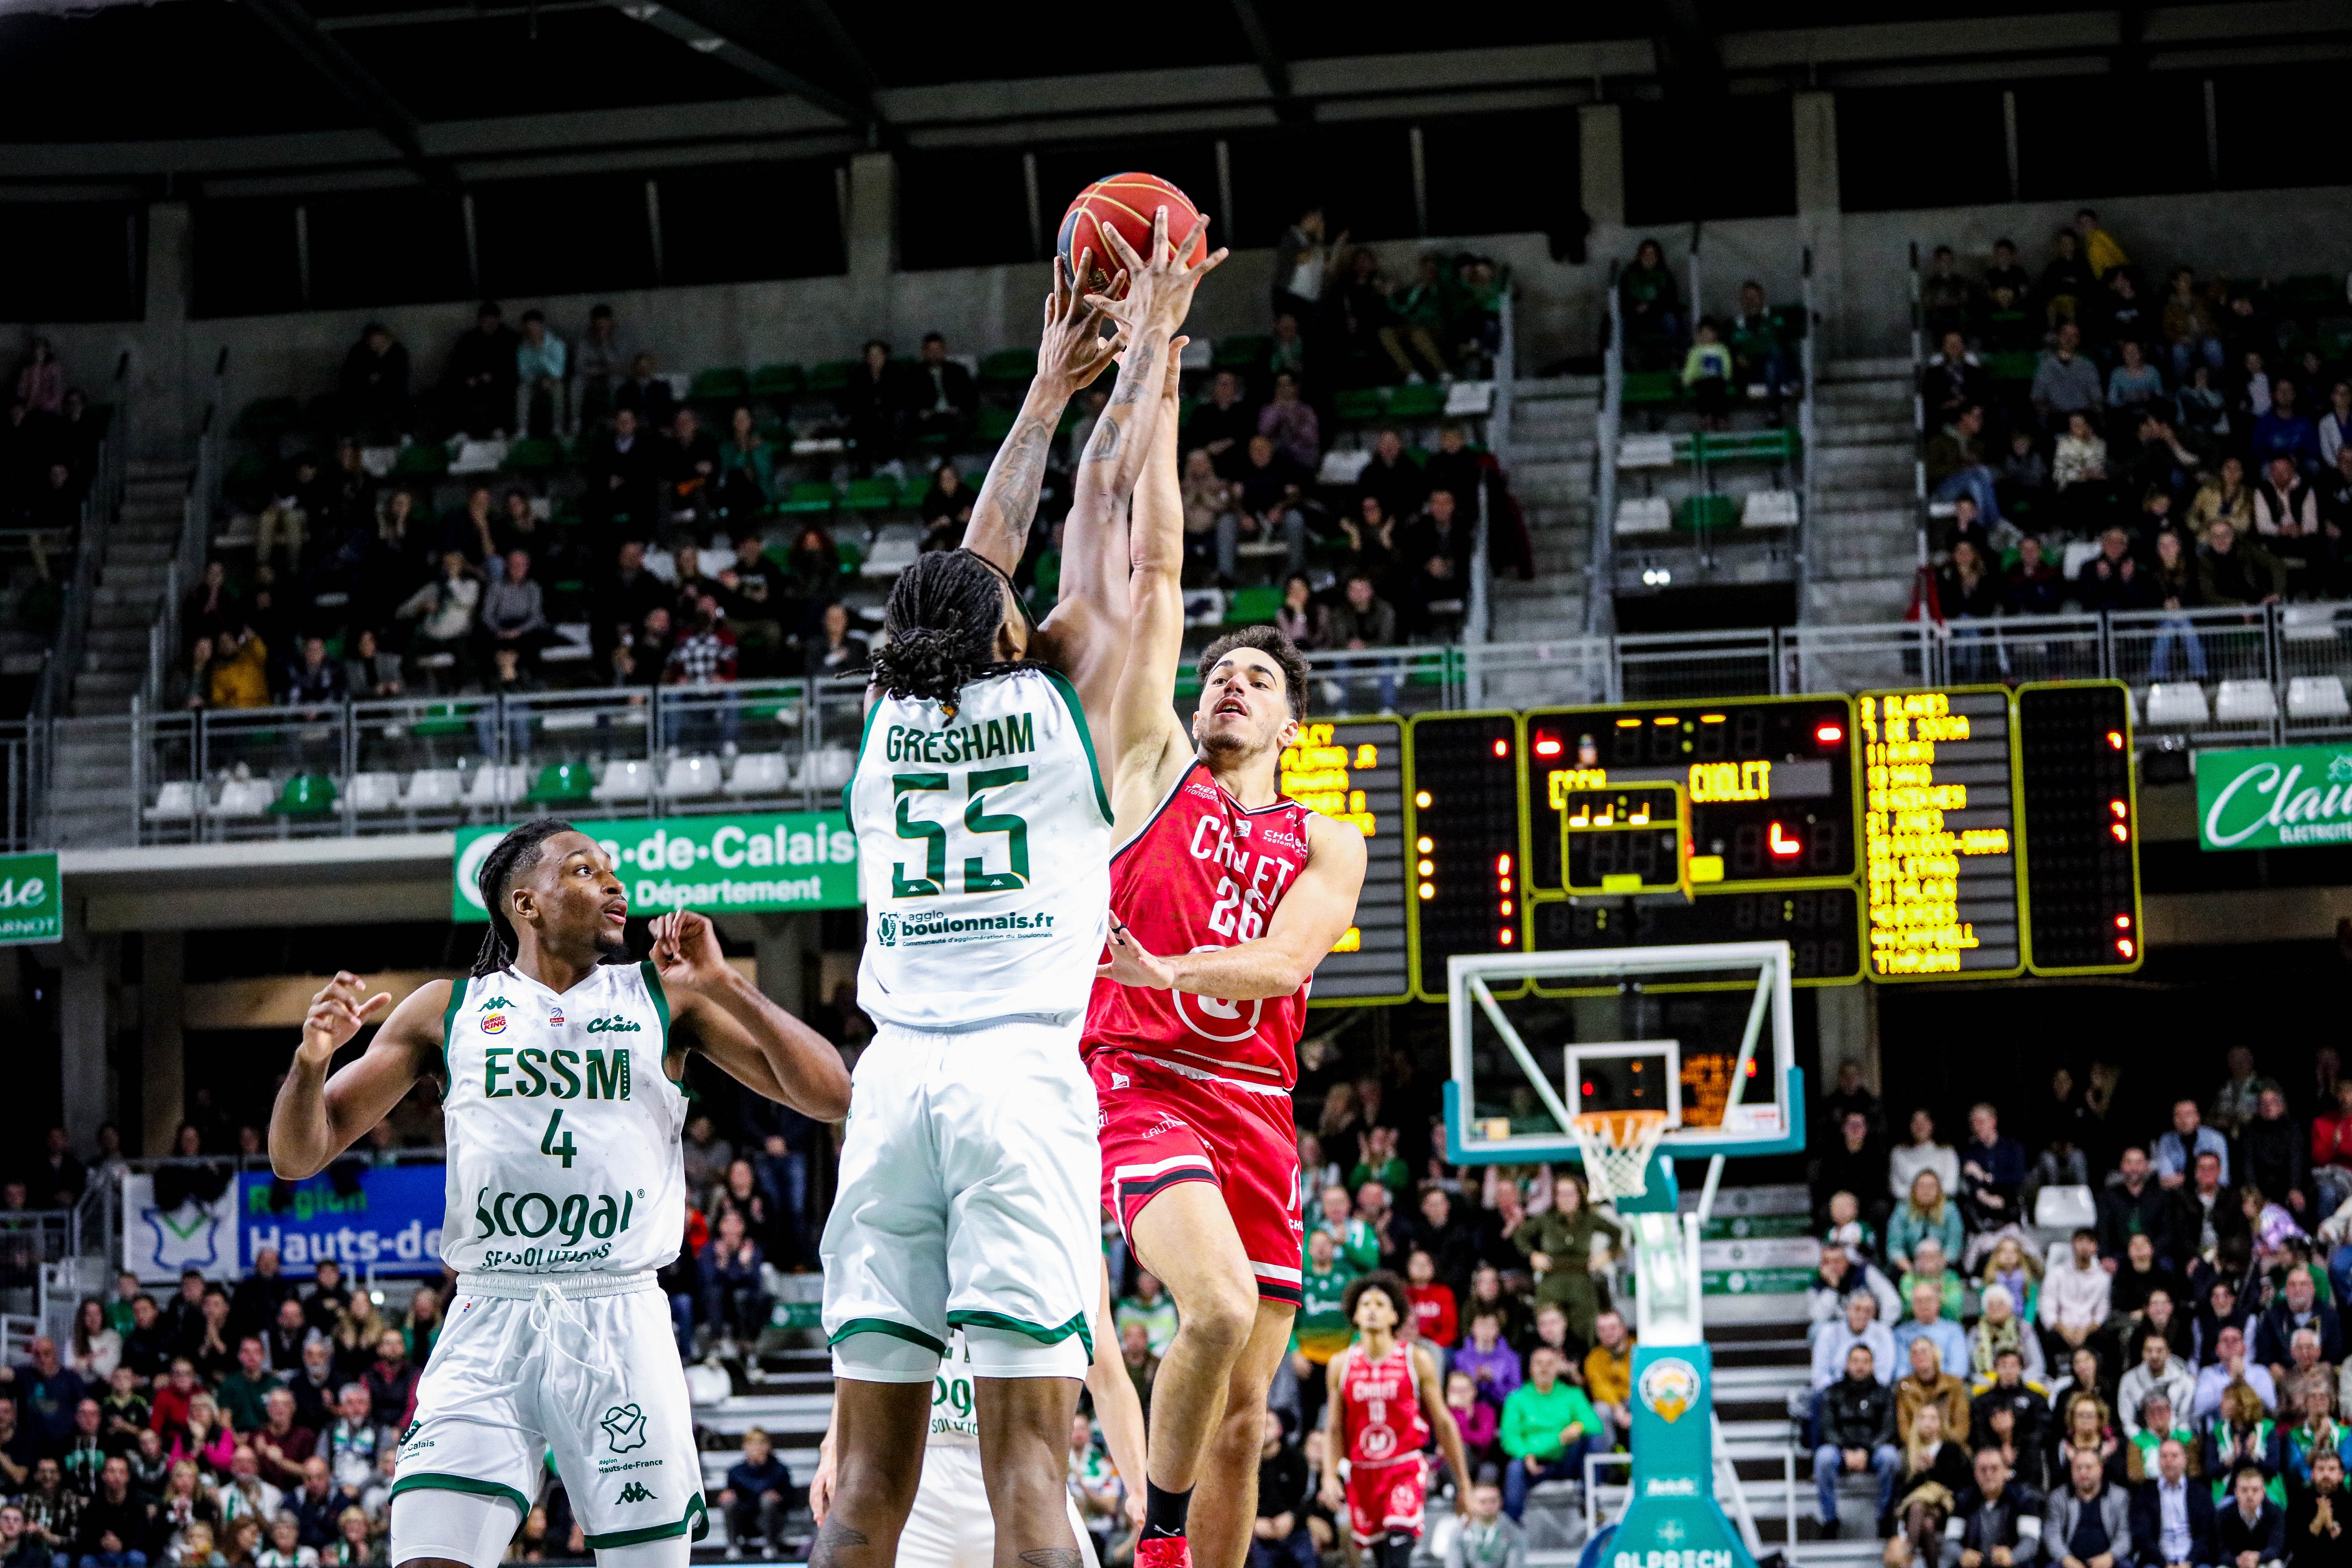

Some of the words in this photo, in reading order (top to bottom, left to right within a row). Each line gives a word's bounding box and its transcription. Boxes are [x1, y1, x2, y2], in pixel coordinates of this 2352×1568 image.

[886, 713, 1035, 763] GRESHAM
[892, 765, 1030, 898] 55
[635, 875, 821, 910] Département
[902, 912, 1054, 936] boulonnais.fr
[909, 910, 944, 922] agglo
[1207, 876, 1266, 943] 26
[903, 938, 947, 947] Communauté
[948, 934, 1004, 943] d'agglomération
[483, 1016, 505, 1025] BURGER
[484, 1020, 506, 1031] KING
[485, 1048, 631, 1101] ESSM
[541, 1109, 577, 1168] 4
[599, 1460, 663, 1474] Hauts-de-France
